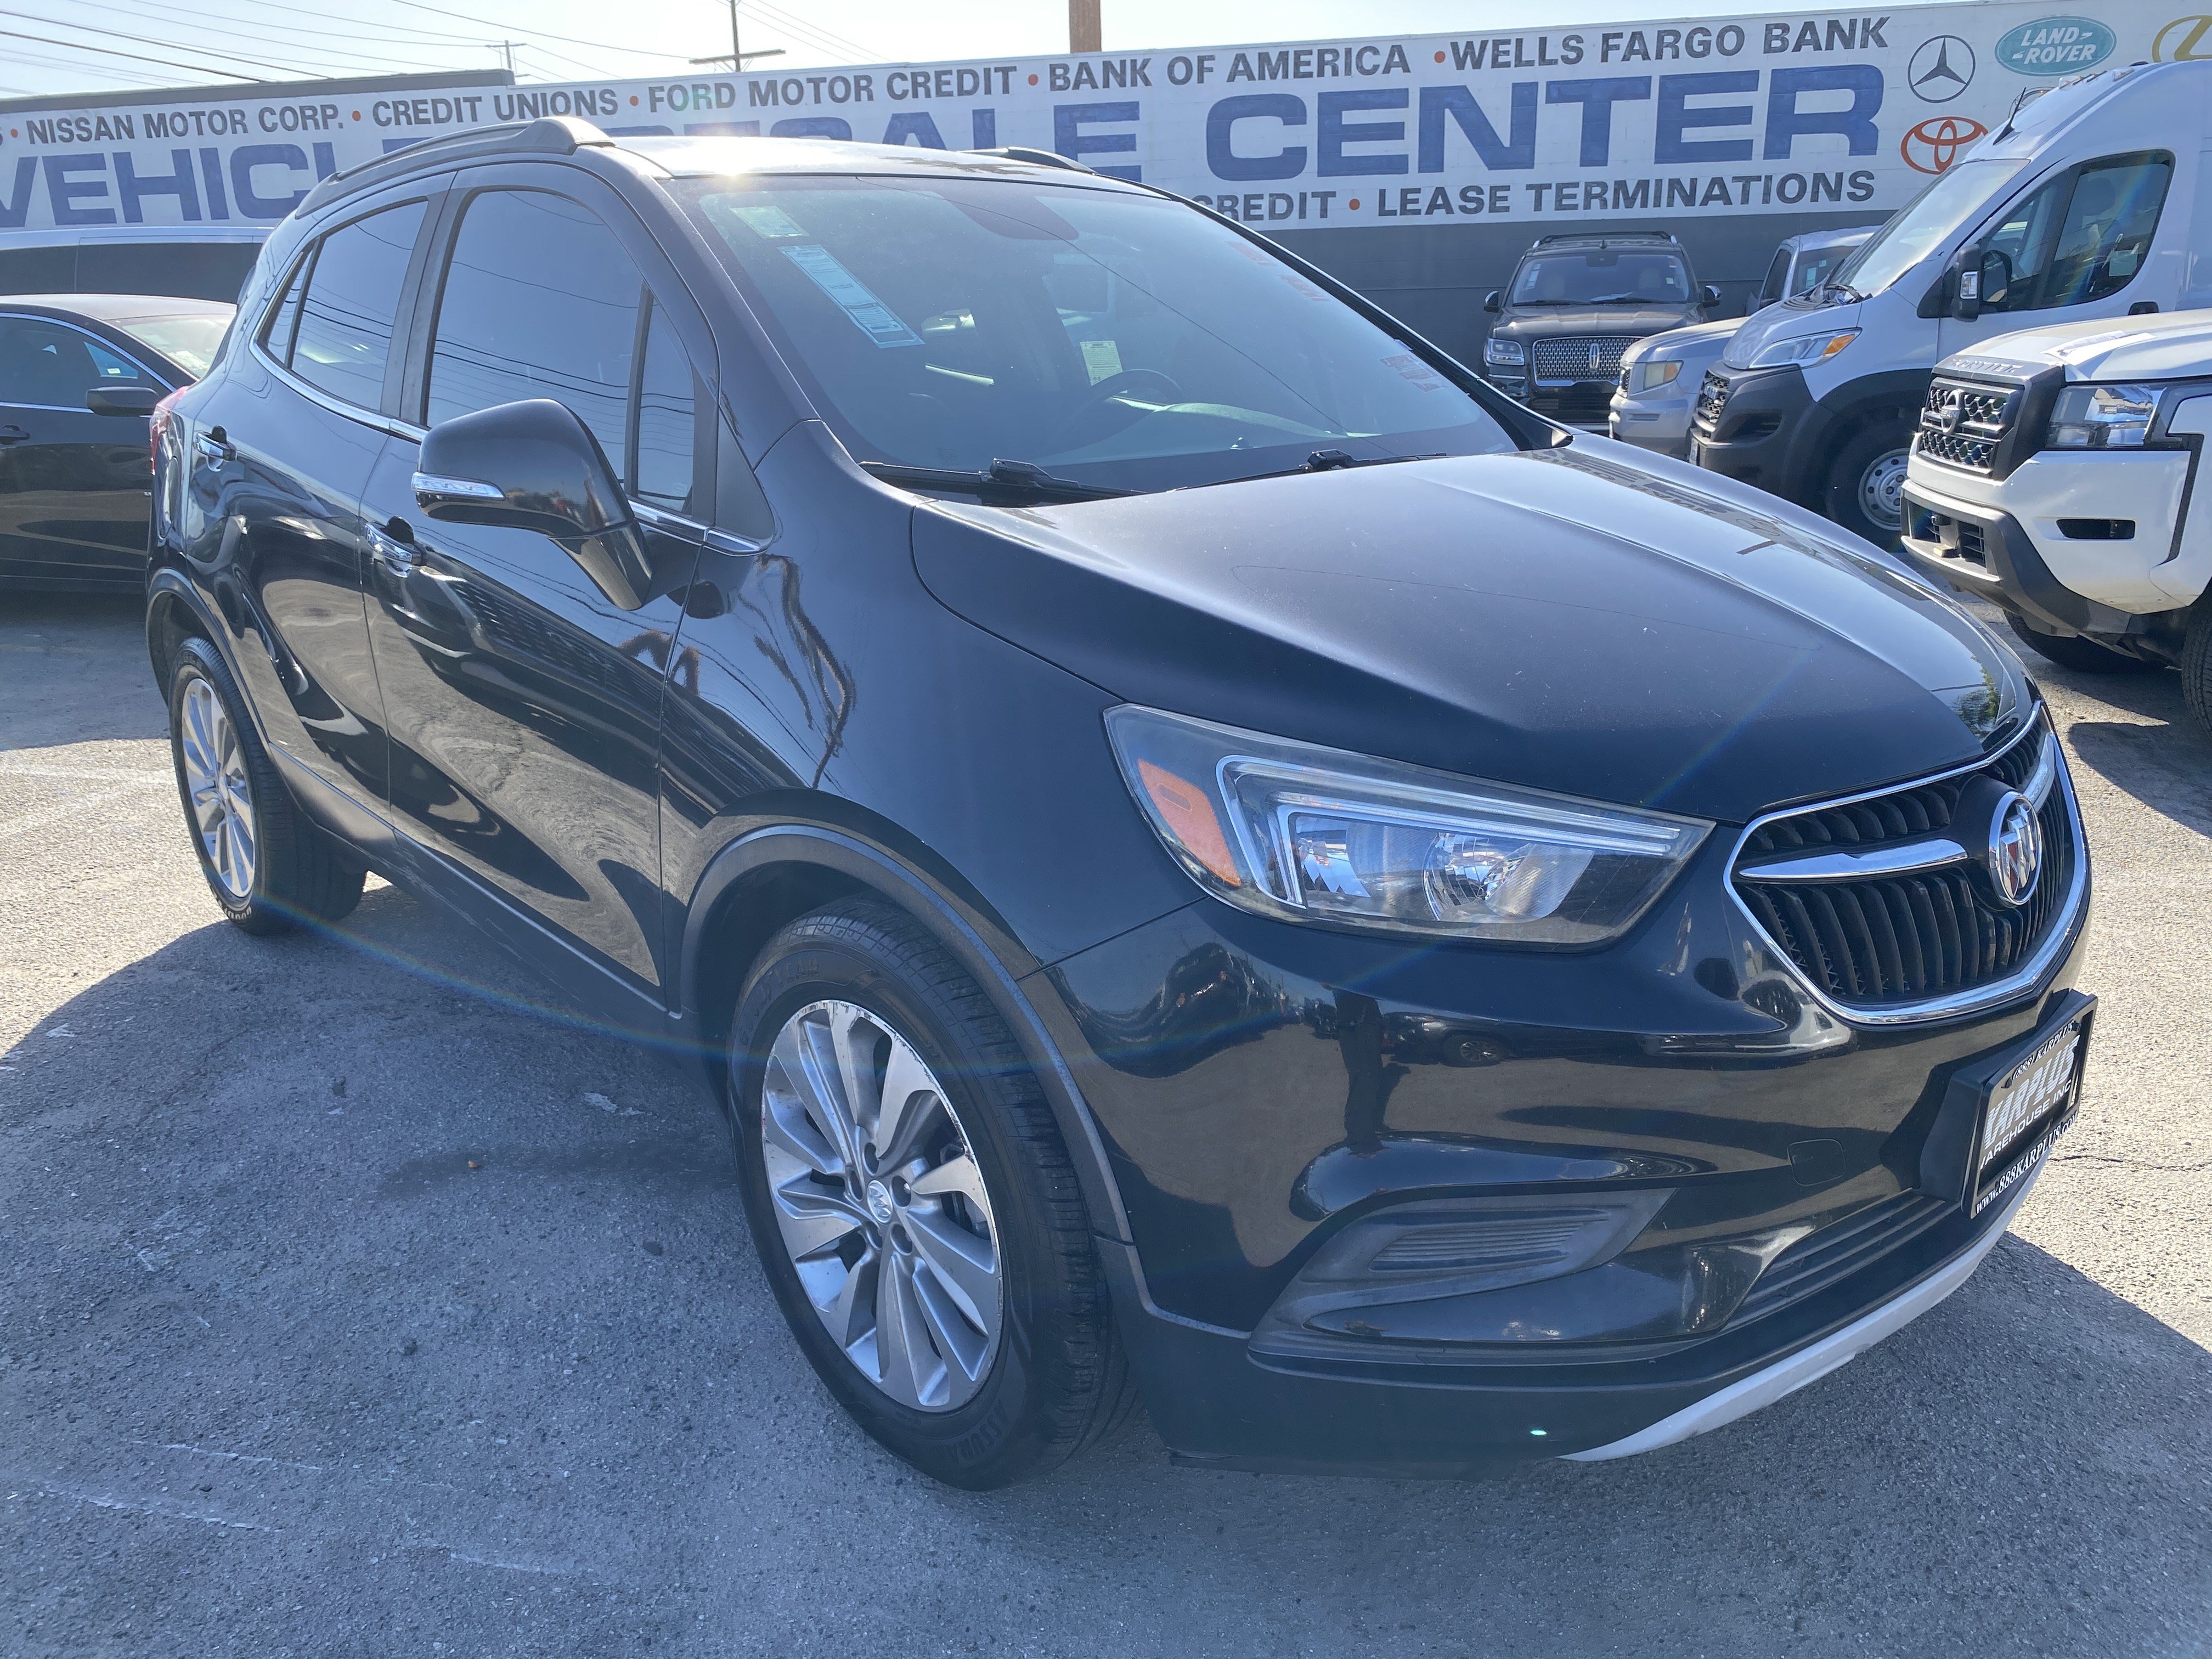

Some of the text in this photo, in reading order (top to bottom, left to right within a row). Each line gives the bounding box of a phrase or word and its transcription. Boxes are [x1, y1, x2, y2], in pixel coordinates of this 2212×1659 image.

[1450, 16, 1891, 70] WELLS FARGO BANK
[648, 65, 1018, 112] FORD MOTOR CREDIT
[1049, 44, 1411, 92] BANK OF AMERICA
[26, 103, 344, 144] NISSAN MOTOR CORP.
[371, 88, 619, 127] CREDIT UNIONS
[1206, 64, 1884, 181] CENTER
[1378, 170, 1875, 216] LEASE TERMINATIONS
[2012, 1019, 2074, 1080] (888) KARPLUS
[1983, 1035, 2080, 1150] KARPLUS
[2053, 1079, 2072, 1103] INC
